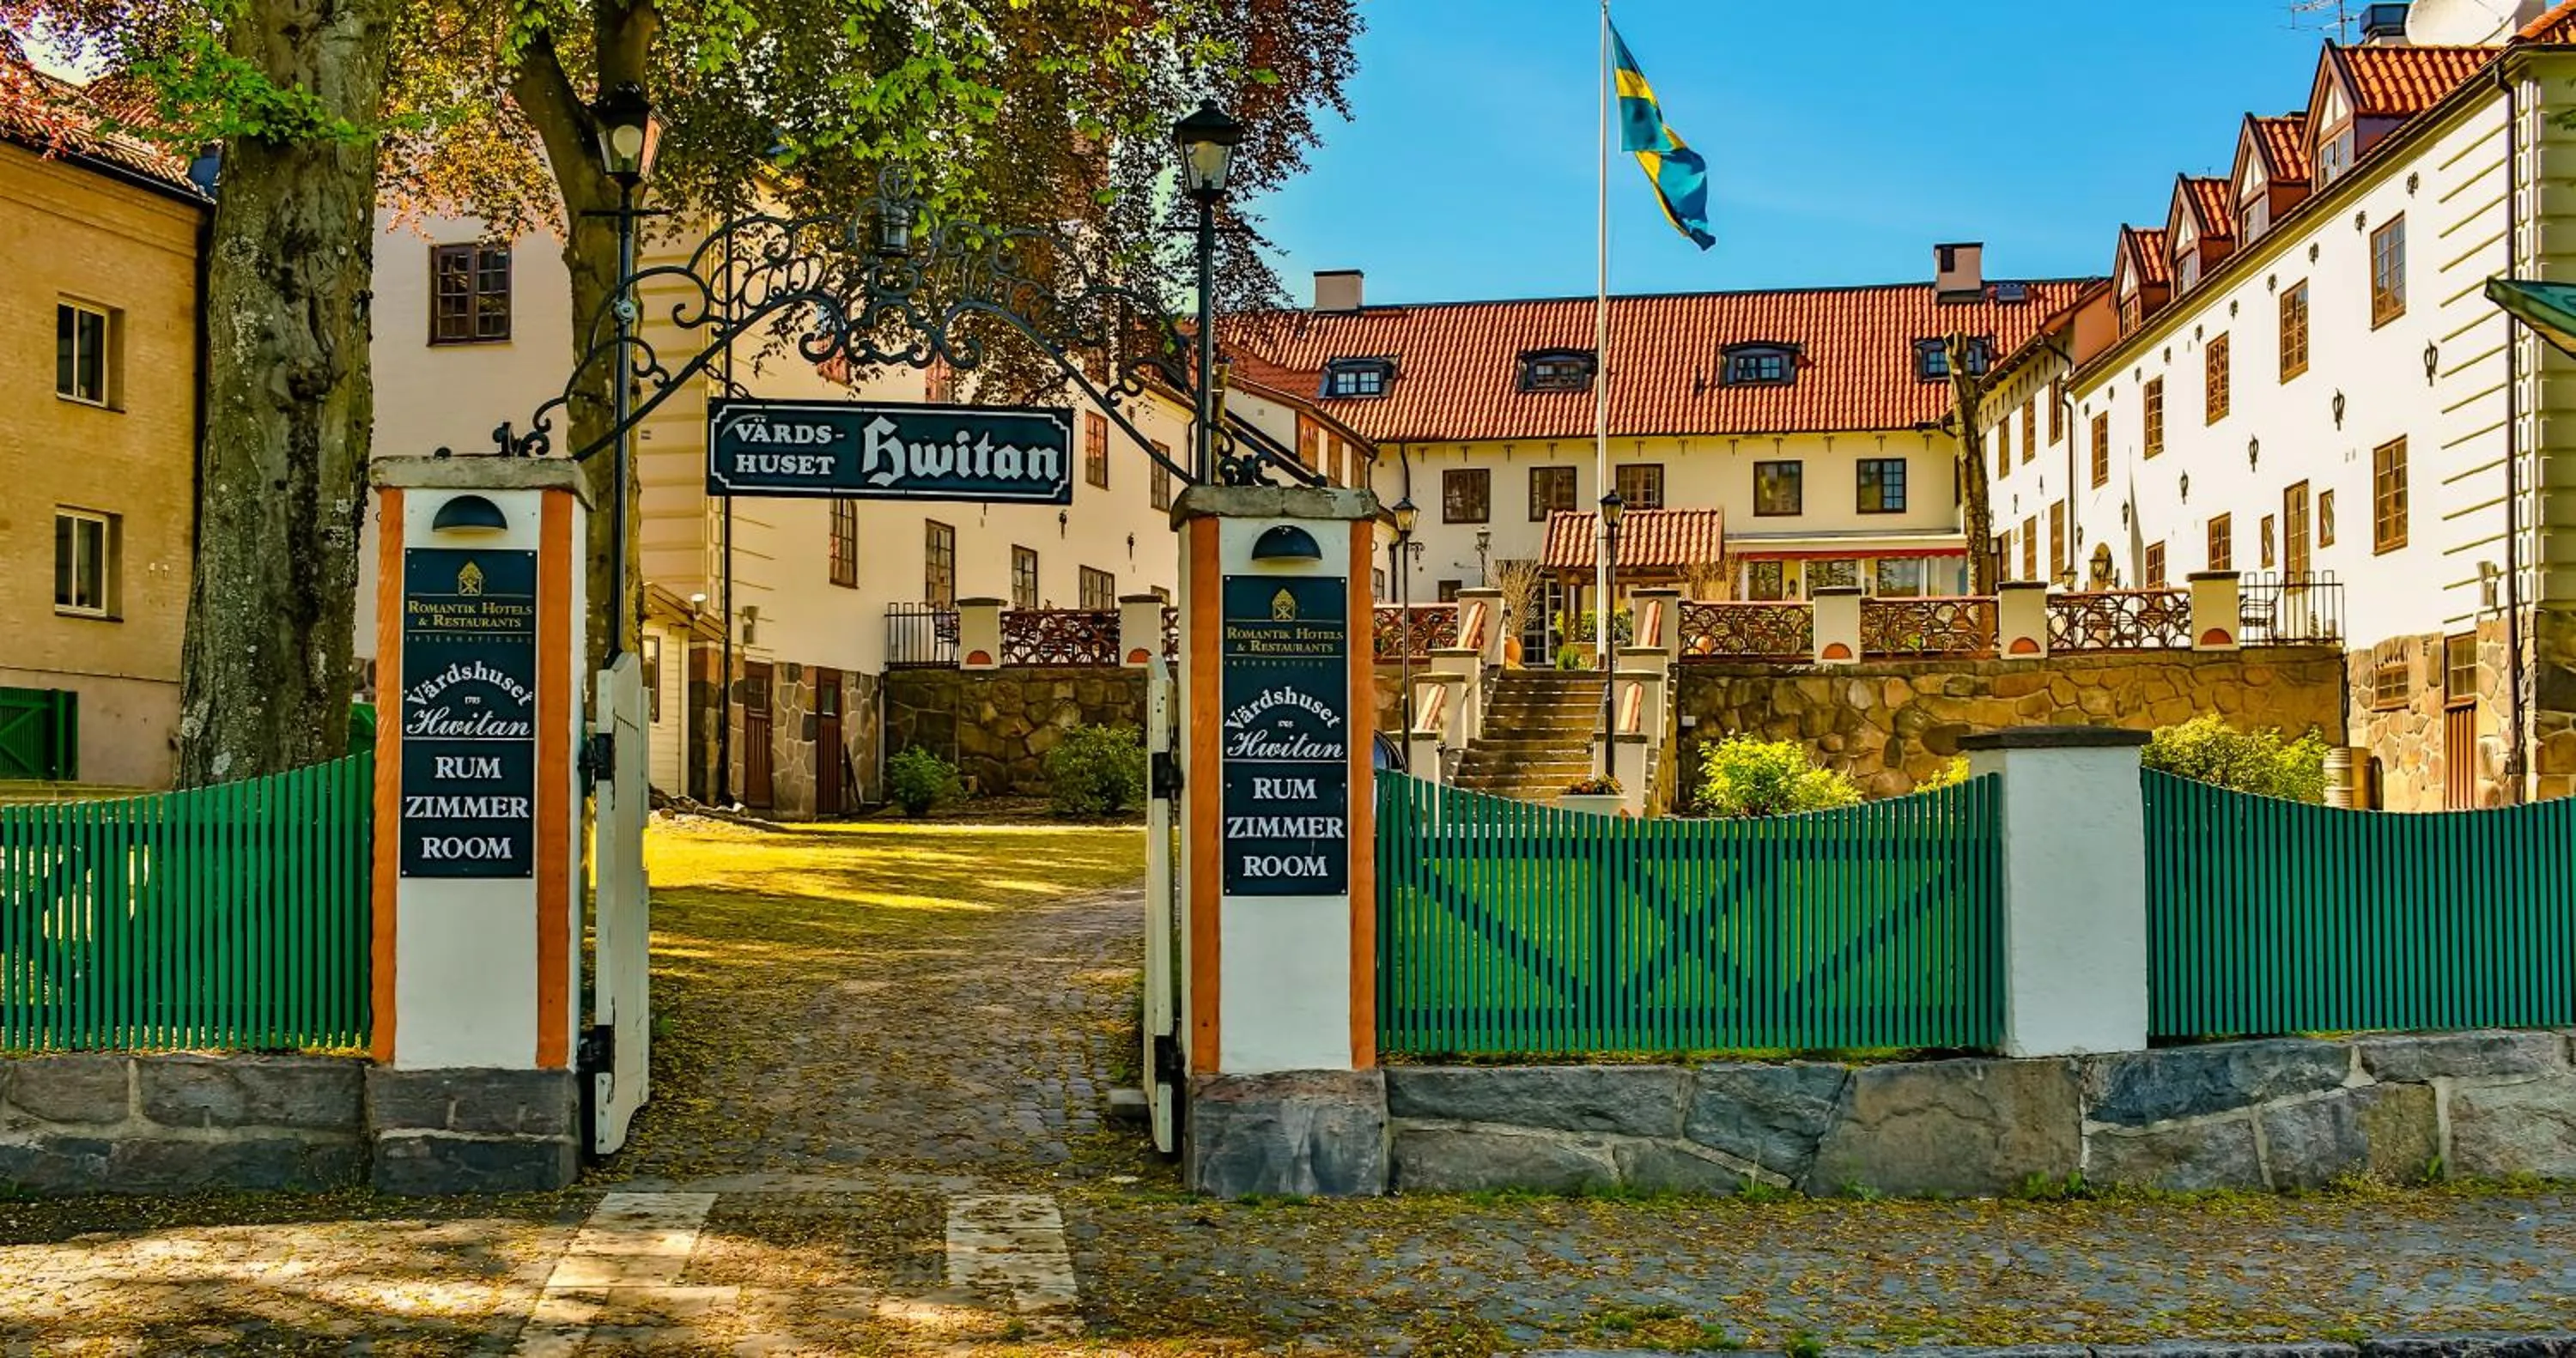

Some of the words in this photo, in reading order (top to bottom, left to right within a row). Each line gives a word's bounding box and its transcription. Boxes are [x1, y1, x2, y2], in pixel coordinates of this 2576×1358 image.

[735, 417, 844, 444] VÄRDS-
[862, 415, 1060, 487] Hwitan
[735, 454, 835, 475] HUSET
[408, 600, 476, 614] ROMANTIK
[482, 602, 532, 615] HOTELS
[418, 617, 428, 626] &
[433, 614, 522, 627] RESTAURANTS
[1226, 627, 1291, 640] ROMANTIK
[1296, 627, 1344, 640] HOTELS
[1250, 640, 1334, 653] RESTAURANTS
[405, 660, 533, 706] Värdshuset
[1224, 686, 1341, 730] Värdshuset
[406, 706, 530, 736] Hwitan
[1226, 729, 1344, 758] Hwitan
[434, 756, 502, 779] RUM
[1253, 778, 1318, 799] RUM
[405, 796, 530, 818] ZIMMER
[1227, 816, 1346, 839] ZIMMER
[422, 837, 513, 859] ROOM
[1242, 856, 1328, 876] ROOM
